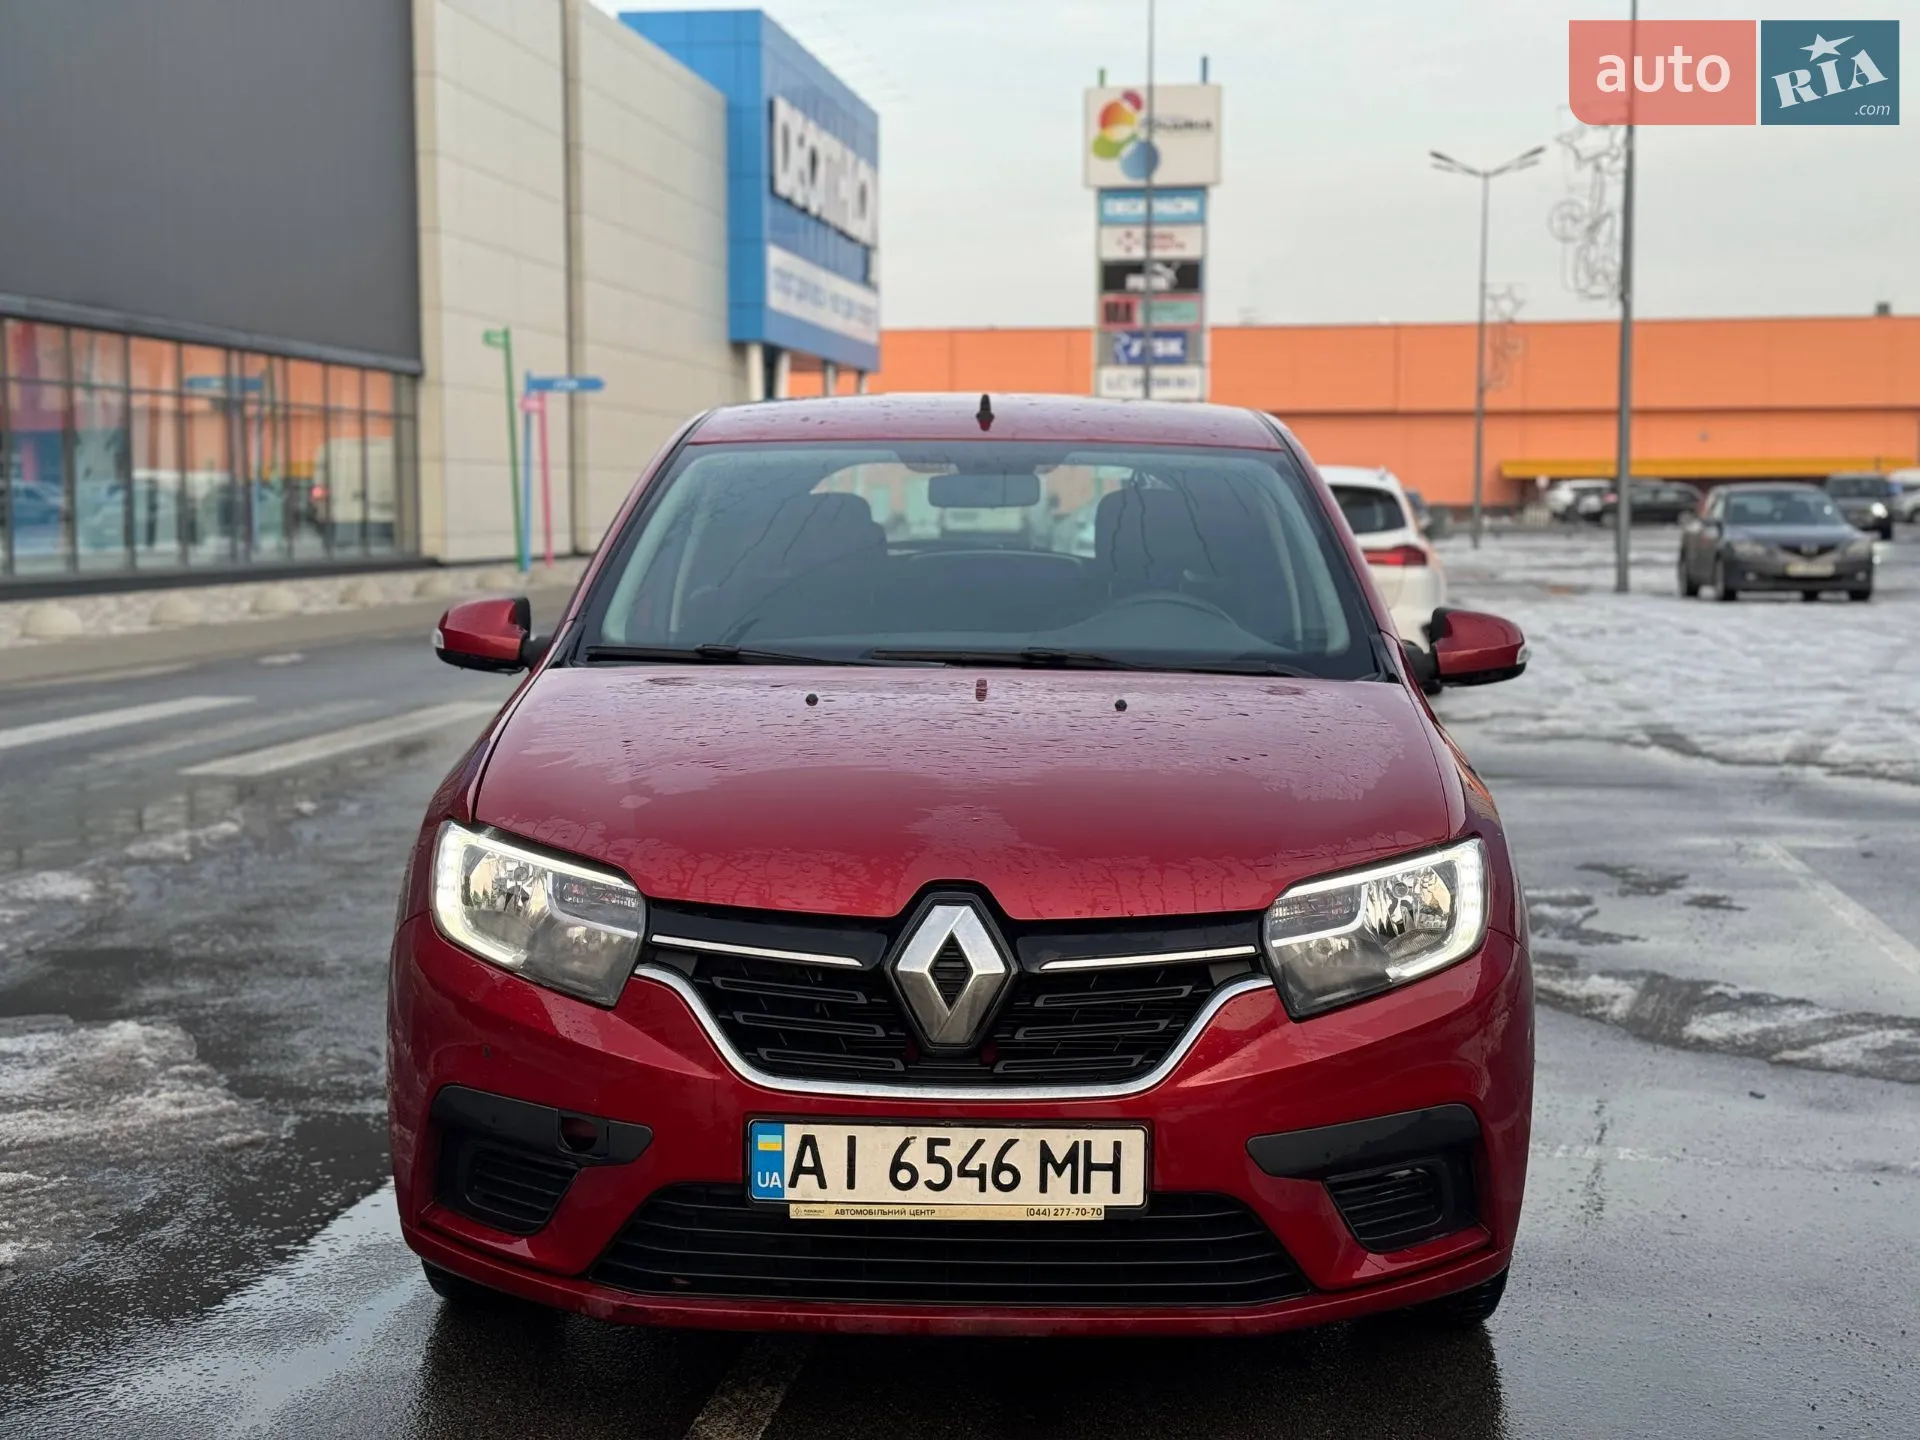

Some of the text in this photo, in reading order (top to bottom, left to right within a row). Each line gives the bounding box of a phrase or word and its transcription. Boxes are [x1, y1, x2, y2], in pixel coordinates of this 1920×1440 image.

[788, 1133, 1122, 1194] AI 6546 MH
[757, 1172, 782, 1188] UA
[834, 1207, 1103, 1217] АВТОМОБІЛЬНИЙ ЦЕНТР (044) 277-70-70
